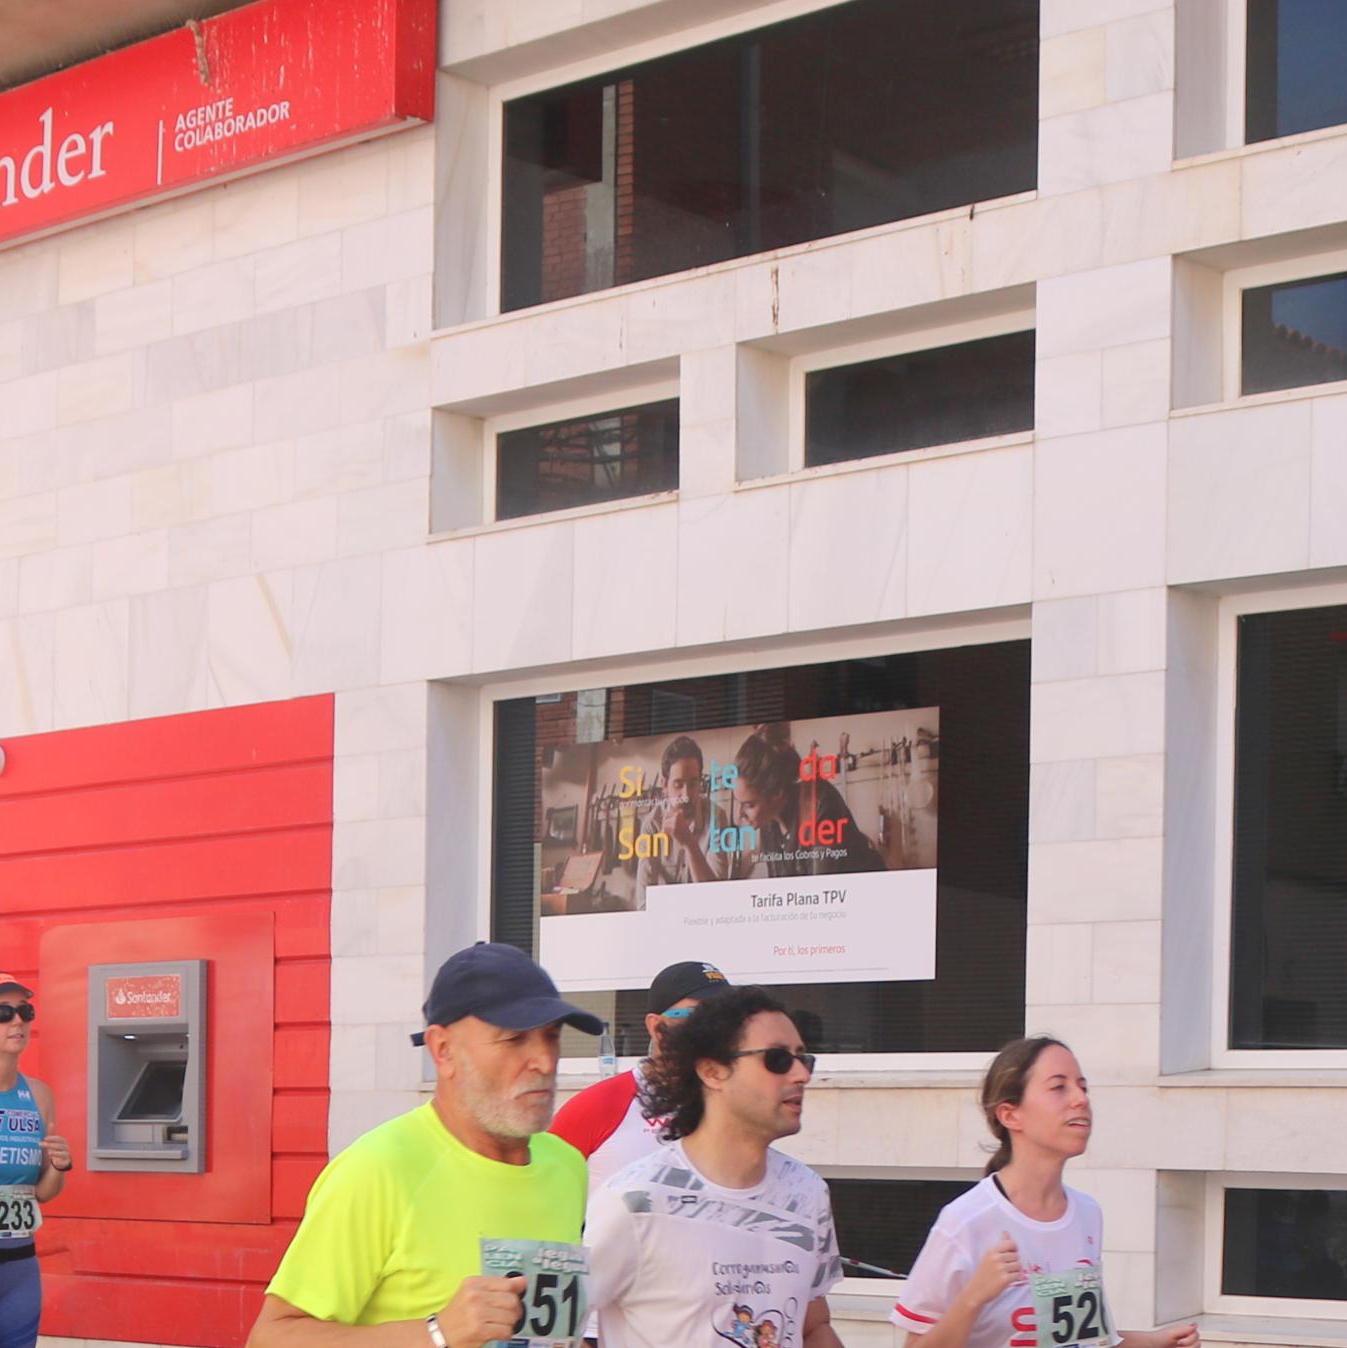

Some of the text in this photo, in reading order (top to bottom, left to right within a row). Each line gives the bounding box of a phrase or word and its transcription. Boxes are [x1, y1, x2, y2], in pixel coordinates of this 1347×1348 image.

[174, 101, 290, 152] COLABORADOR
[175, 97, 233, 132] AGENTE
[618, 748, 838, 799] Si te da
[618, 815, 848, 860] San tan der
[784, 850, 794, 860] los
[795, 848, 819, 860] Cobros
[826, 847, 847, 860] Pagos
[751, 890, 847, 908] Tarifa Plana TPV
[773, 945, 786, 956] Por
[797, 944, 808, 955] los
[810, 943, 845, 957] primeros
[126, 990, 172, 1004] Santander
[8, 1117, 40, 1133] ULSA
[1051, 1291, 1109, 1344] 52
